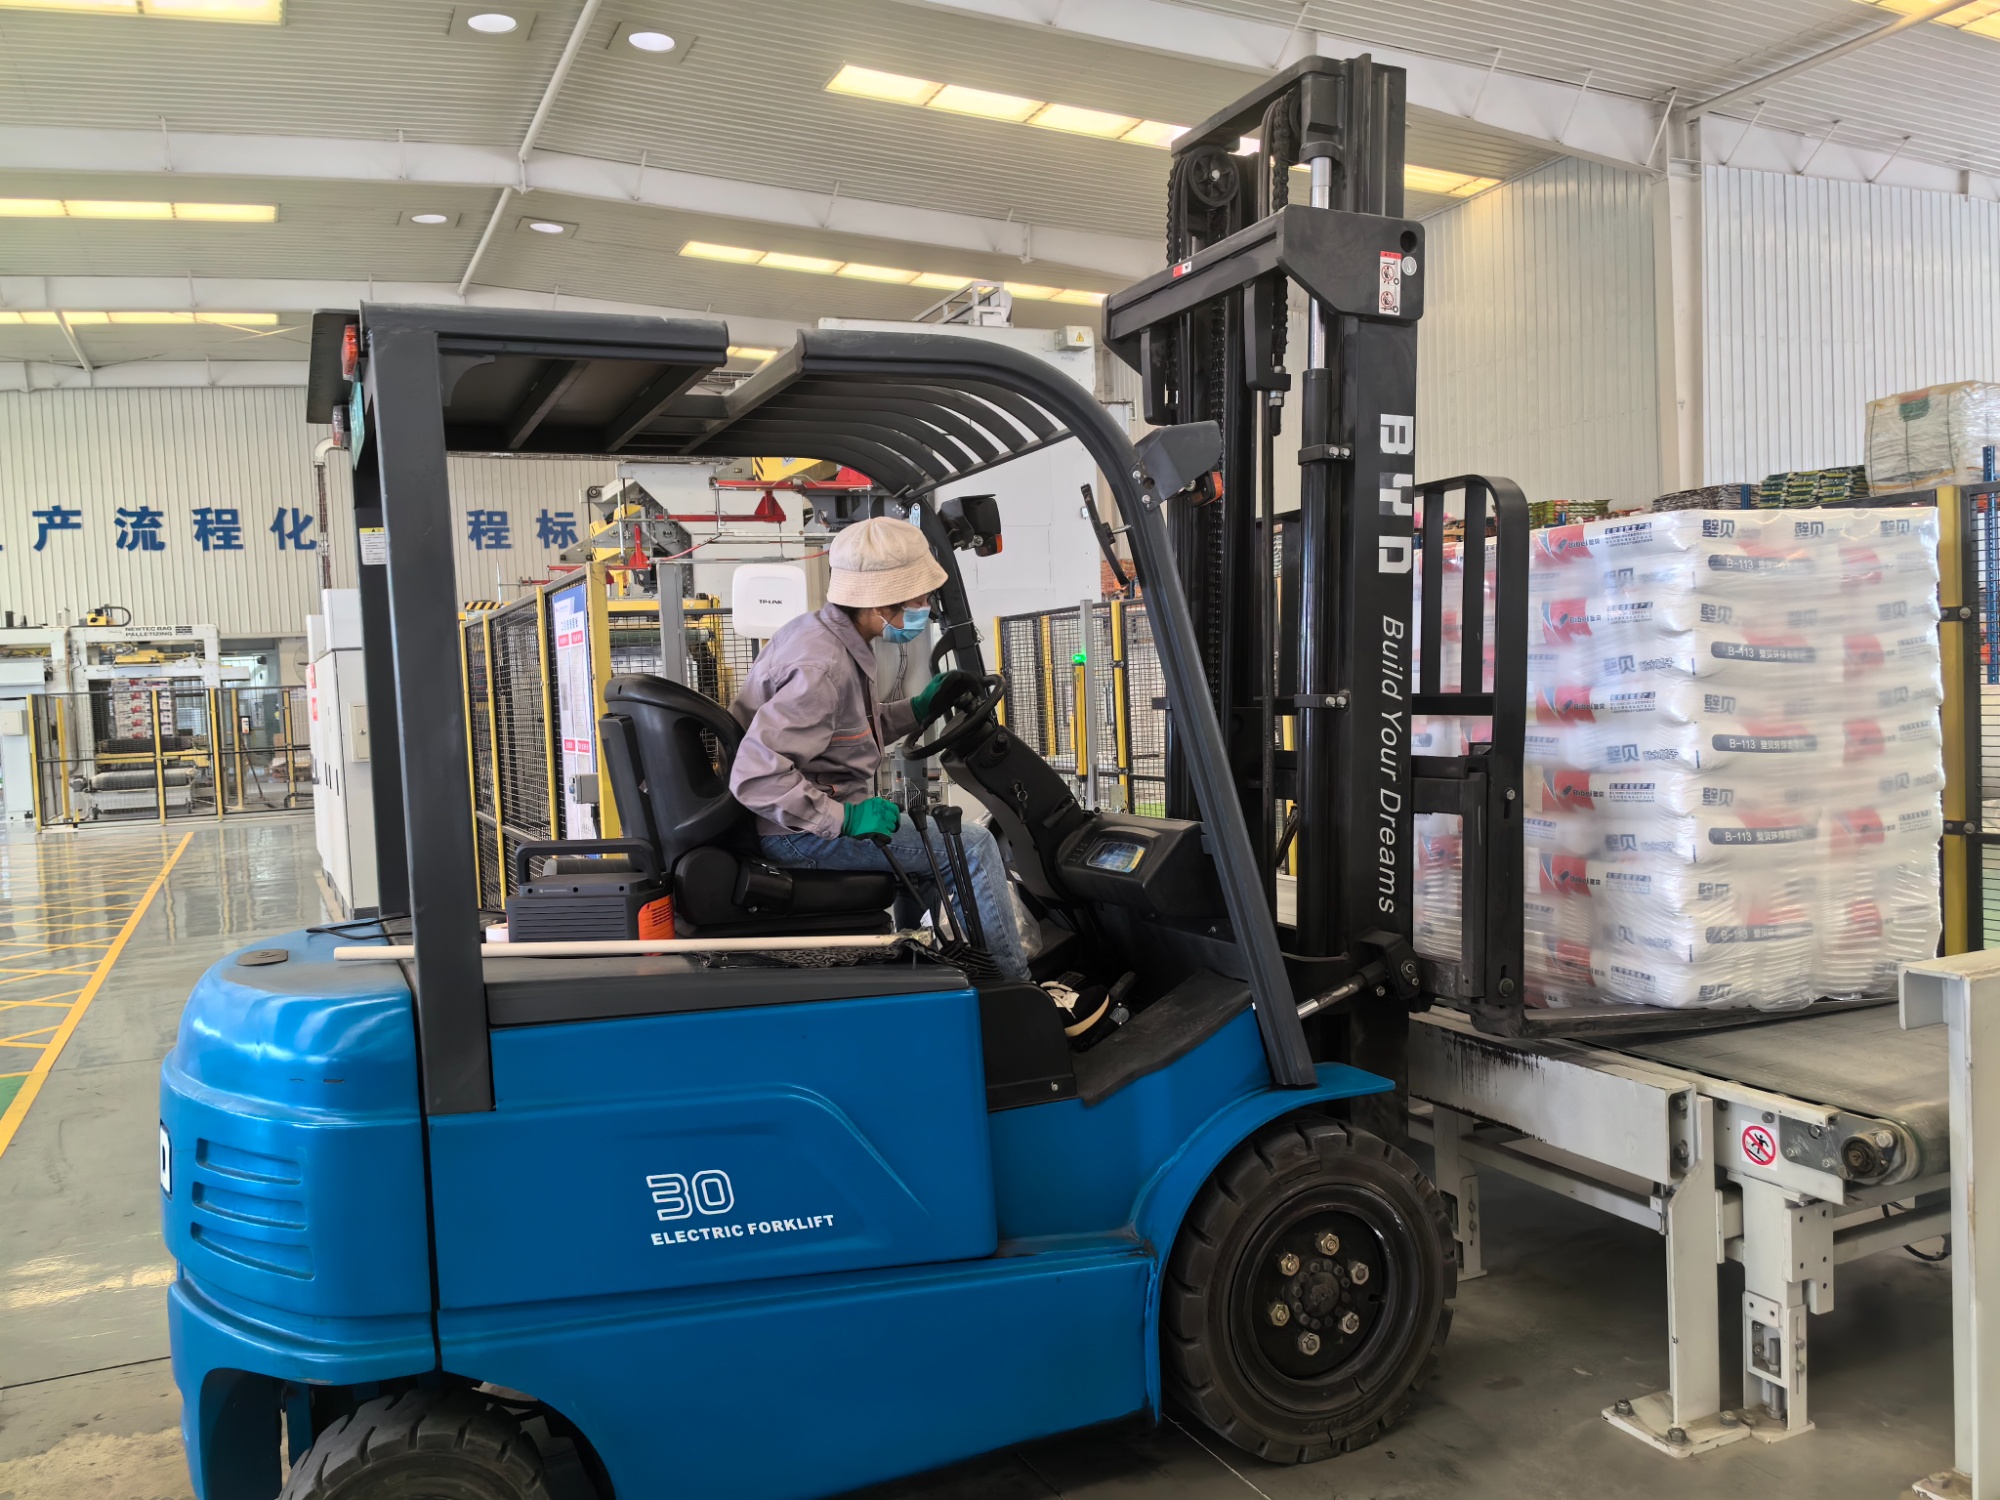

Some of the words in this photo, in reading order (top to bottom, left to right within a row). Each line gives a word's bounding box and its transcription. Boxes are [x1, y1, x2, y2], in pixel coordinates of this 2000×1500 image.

[1378, 414, 1414, 574] BYD
[0, 505, 317, 551] 产流程化
[1702, 518, 1735, 538] 壁贝
[1794, 520, 1824, 539] 壁贝
[1725, 557, 1754, 570] B-113
[1700, 602, 1733, 624] 壁贝
[1382, 615, 1403, 700] Build
[1727, 646, 1755, 658] B-113
[1703, 693, 1736, 715] 壁贝
[1380, 711, 1402, 781] Your
[1729, 738, 1756, 750] B-113
[1702, 786, 1734, 806] 壁贝
[1725, 830, 1752, 842] B-113
[1378, 788, 1401, 913] Dreams
[646, 1170, 734, 1221] 30
[651, 1225, 743, 1246] ELECTRIC
[747, 1214, 834, 1235] FORKLIFT
